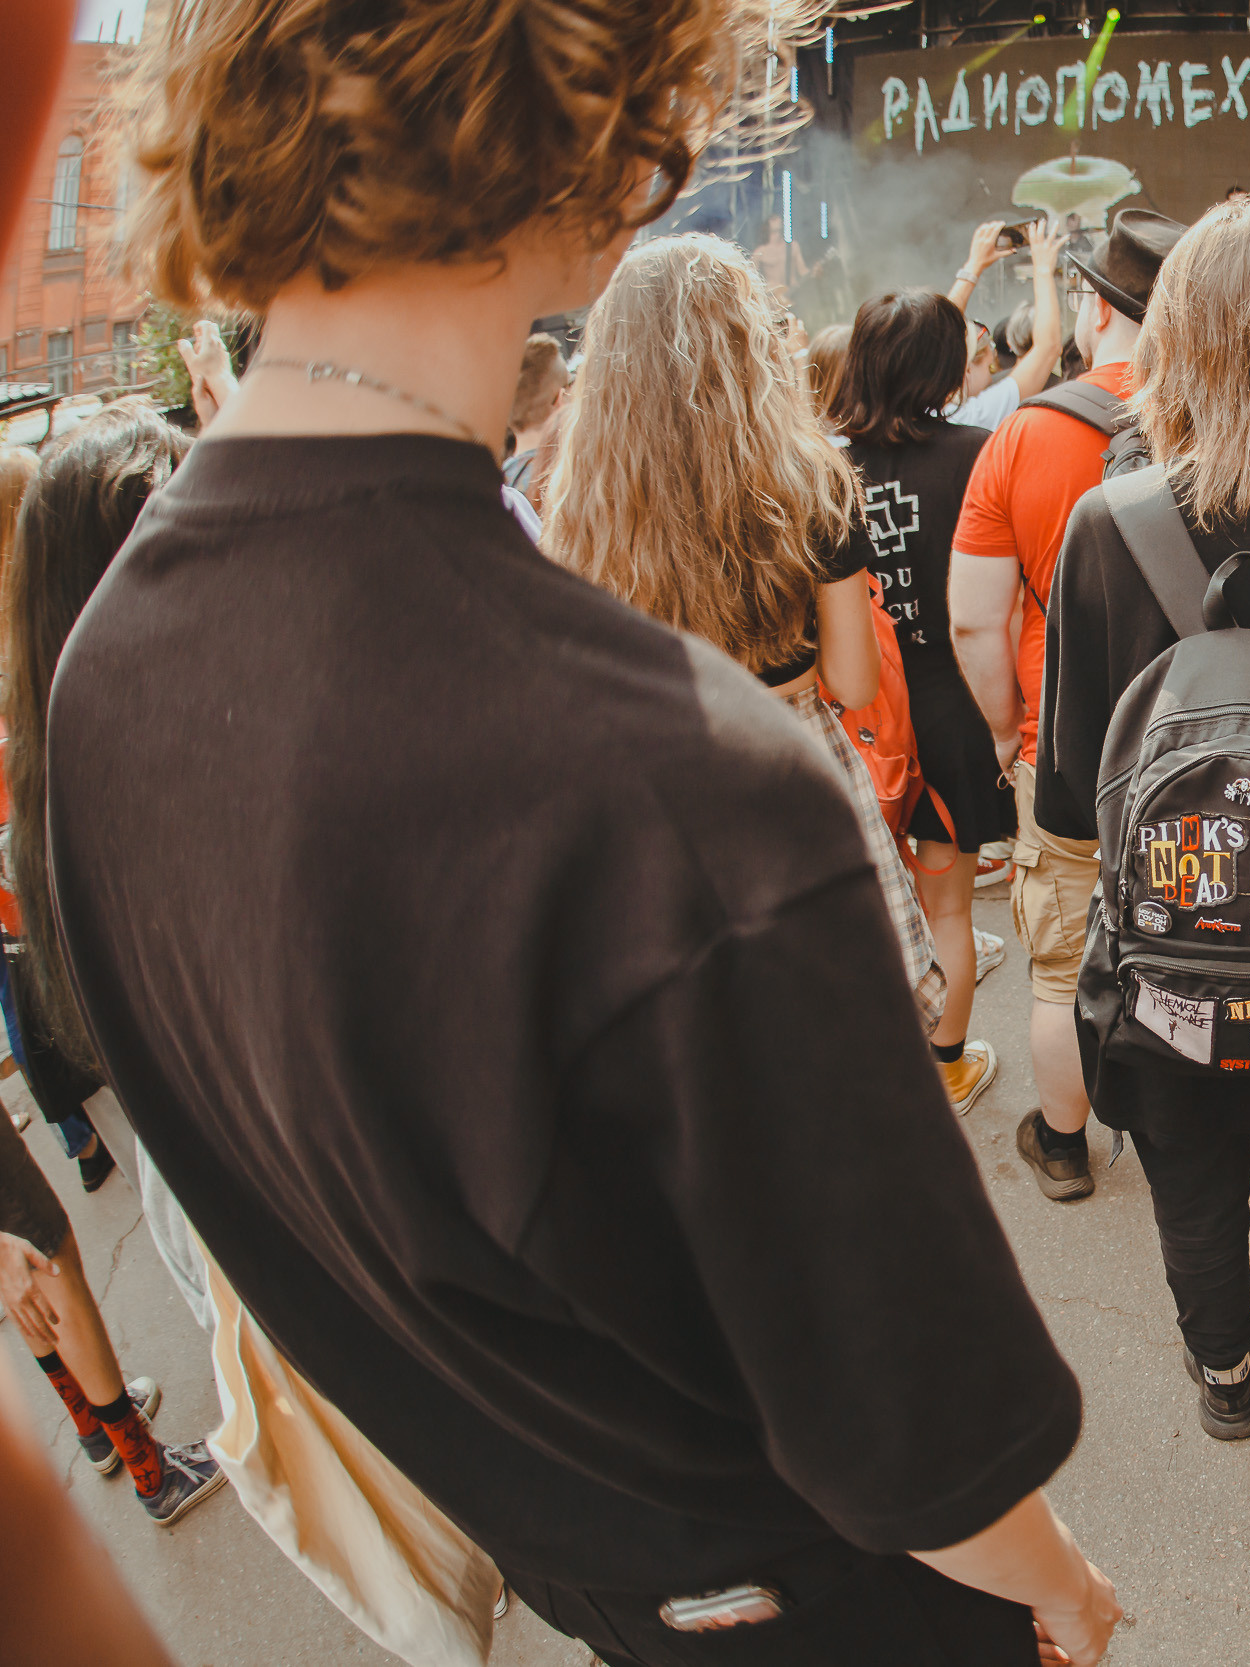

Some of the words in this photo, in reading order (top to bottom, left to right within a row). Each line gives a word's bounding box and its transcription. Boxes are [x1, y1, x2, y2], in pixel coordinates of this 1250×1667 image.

[1139, 814, 1244, 851] PUNK'S
[1150, 840, 1230, 888] NOT
[1164, 873, 1228, 906] DEAD
